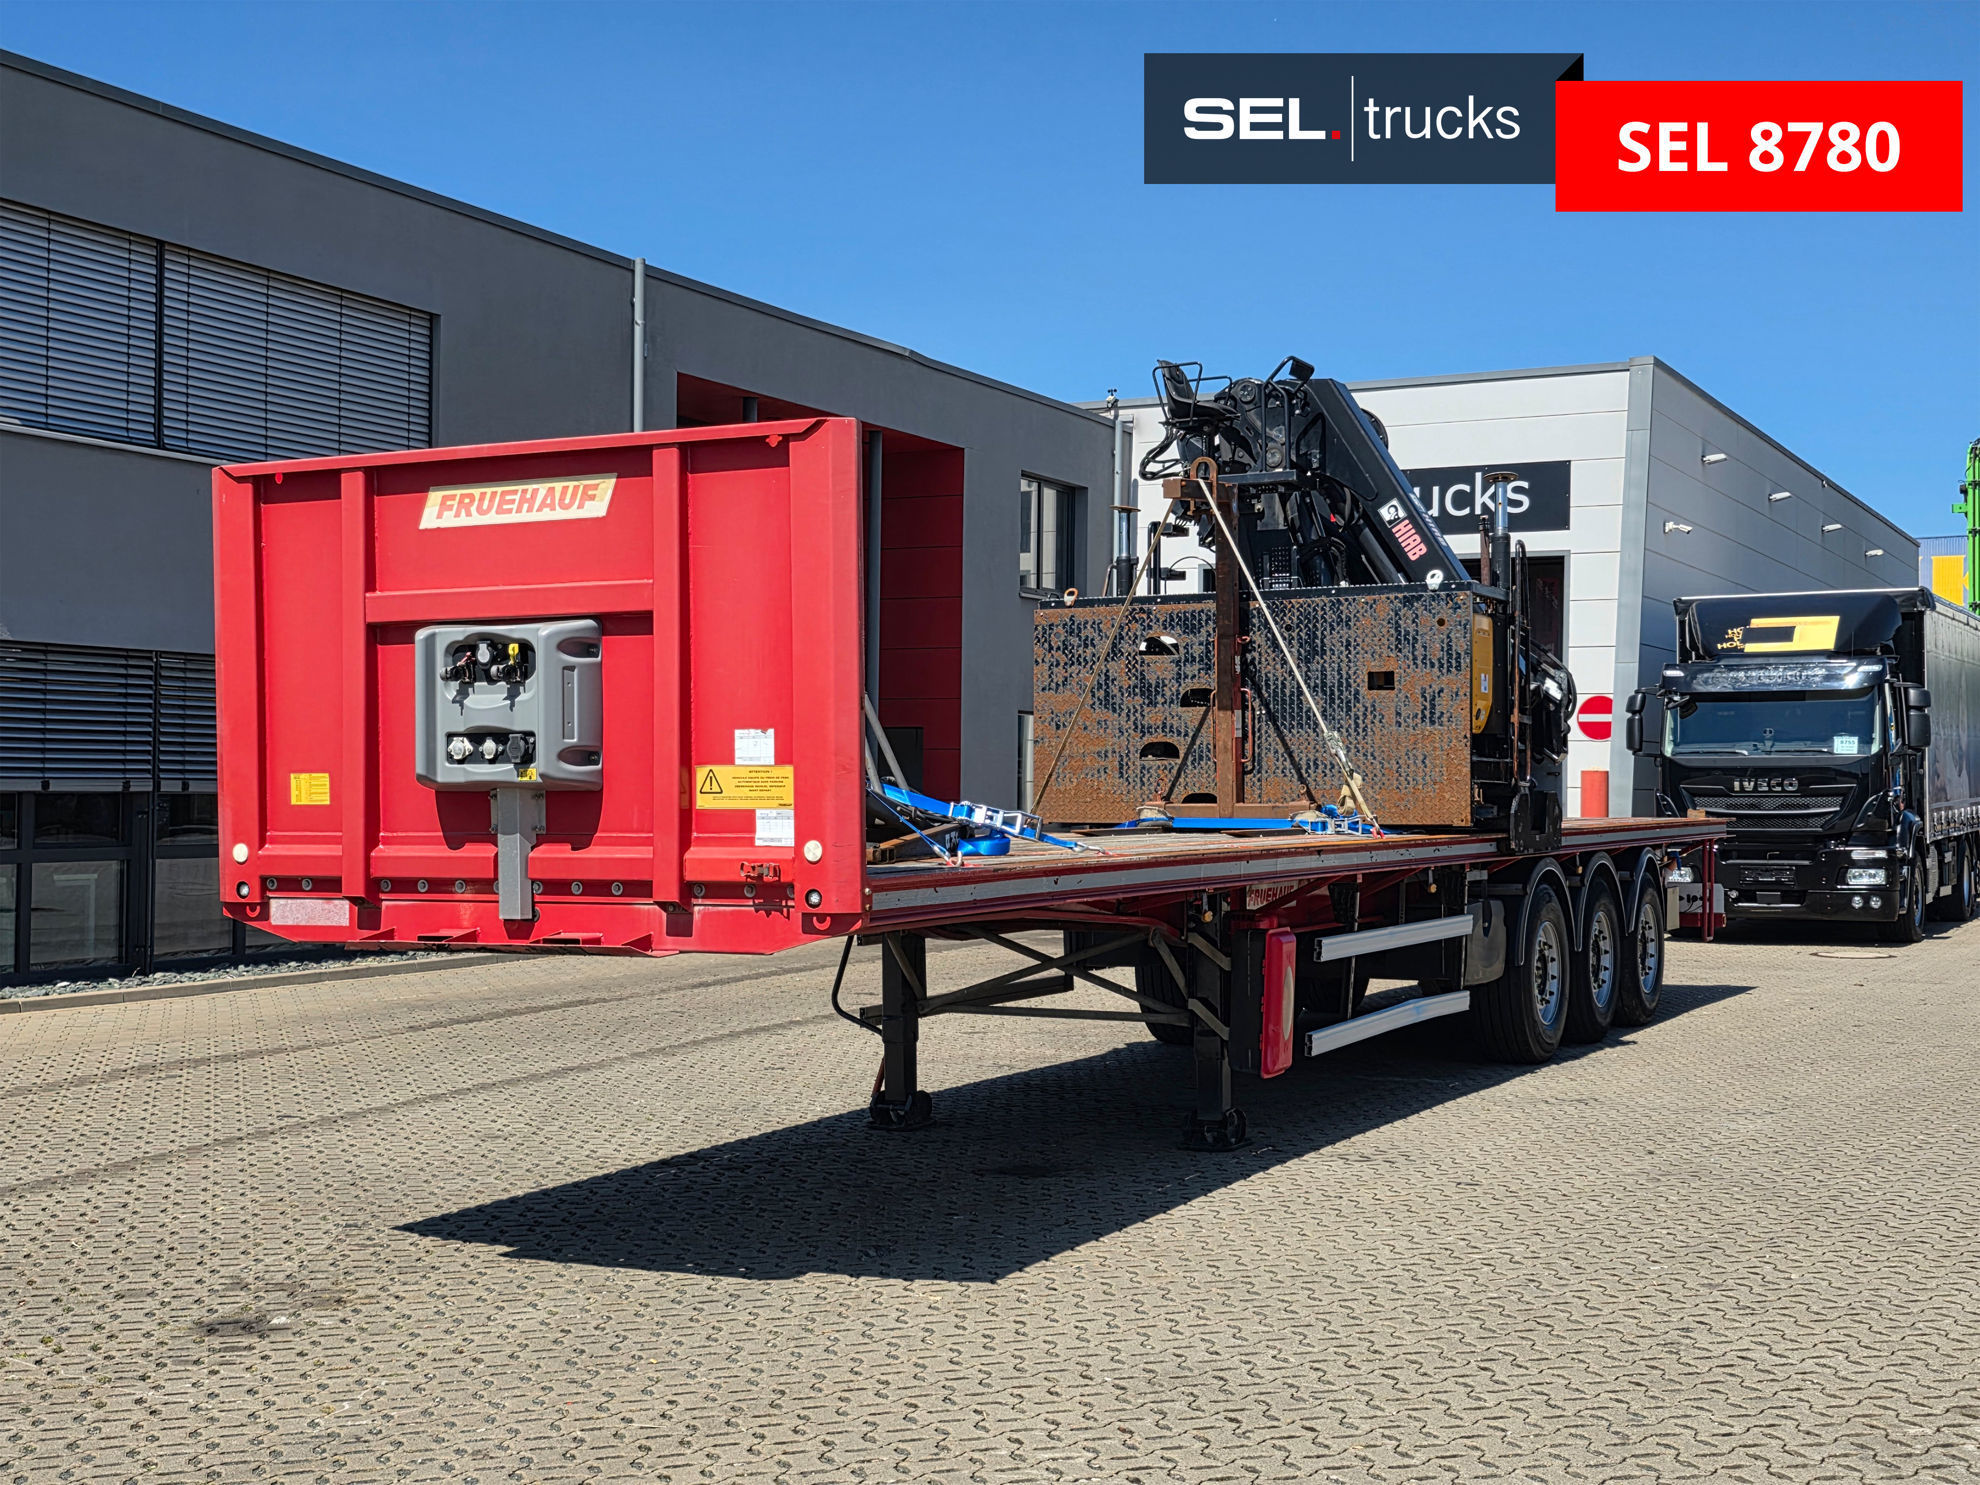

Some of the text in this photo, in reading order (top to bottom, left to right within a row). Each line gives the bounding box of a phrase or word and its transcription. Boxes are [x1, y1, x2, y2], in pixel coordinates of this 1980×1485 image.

[435, 483, 601, 520] FRUEHAUF
[1391, 518, 1428, 562] HIAB
[1733, 777, 1799, 792] IVECO
